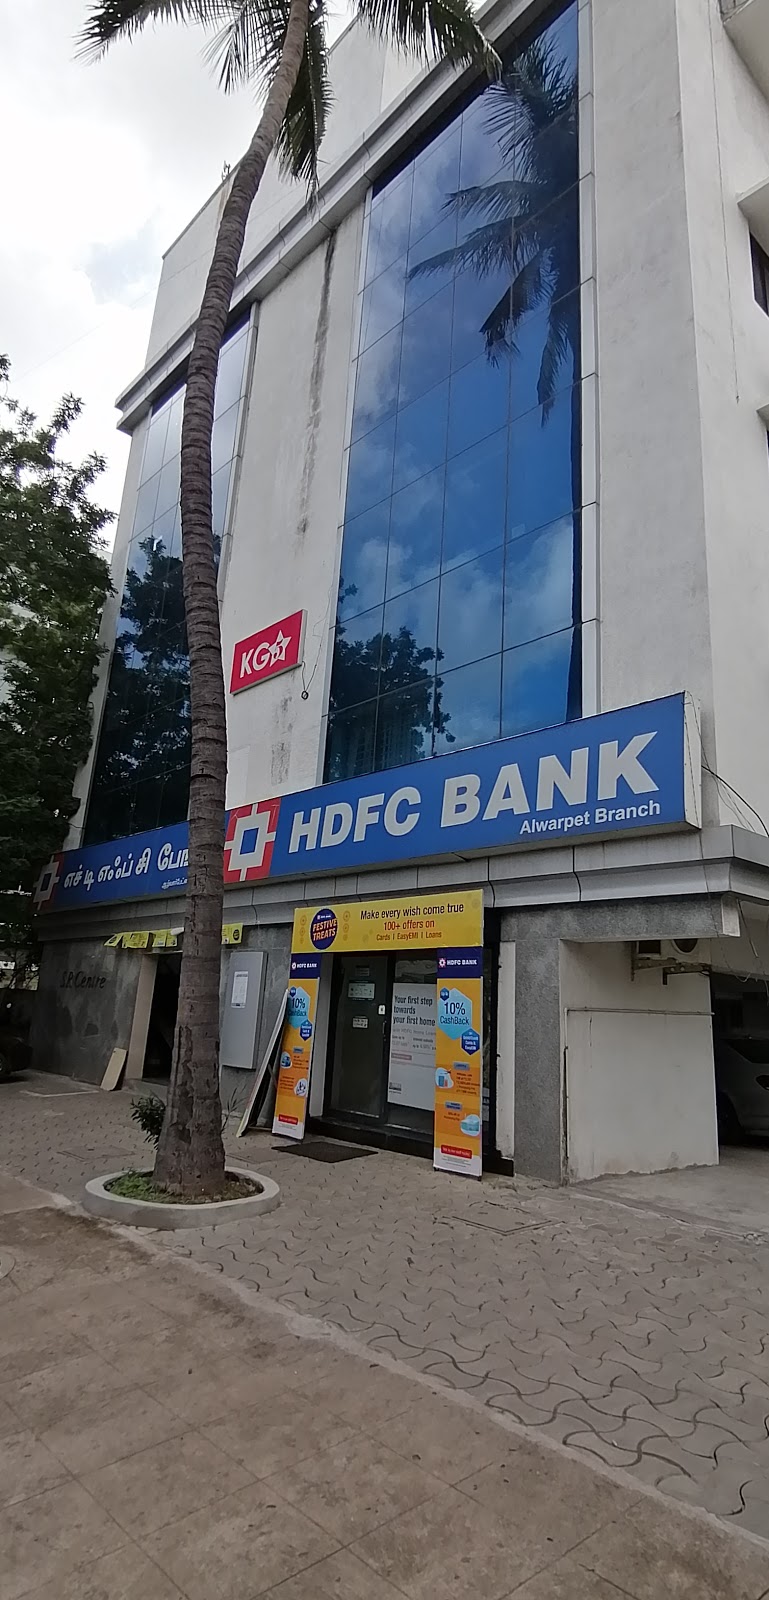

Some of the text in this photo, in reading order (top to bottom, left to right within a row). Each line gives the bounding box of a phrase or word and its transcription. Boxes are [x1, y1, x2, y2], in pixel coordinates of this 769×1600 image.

[287, 730, 660, 855] HDFC BANK
[519, 799, 662, 836] Alwarpet Branch
[360, 902, 465, 920] Make every wish come true
[312, 918, 338, 932] FESTIVE
[383, 919, 435, 931] 100+ offers on
[312, 927, 336, 941] TREATS
[376, 931, 442, 942] Cards EasyEMI Loans
[75, 970, 107, 989] Centre
[291, 998, 306, 1009] 10%
[394, 995, 433, 1008] Your first step
[393, 1005, 416, 1015] towards
[444, 1002, 466, 1016] 10%
[393, 1015, 436, 1027] your first home
[439, 1015, 470, 1026] CashBack
